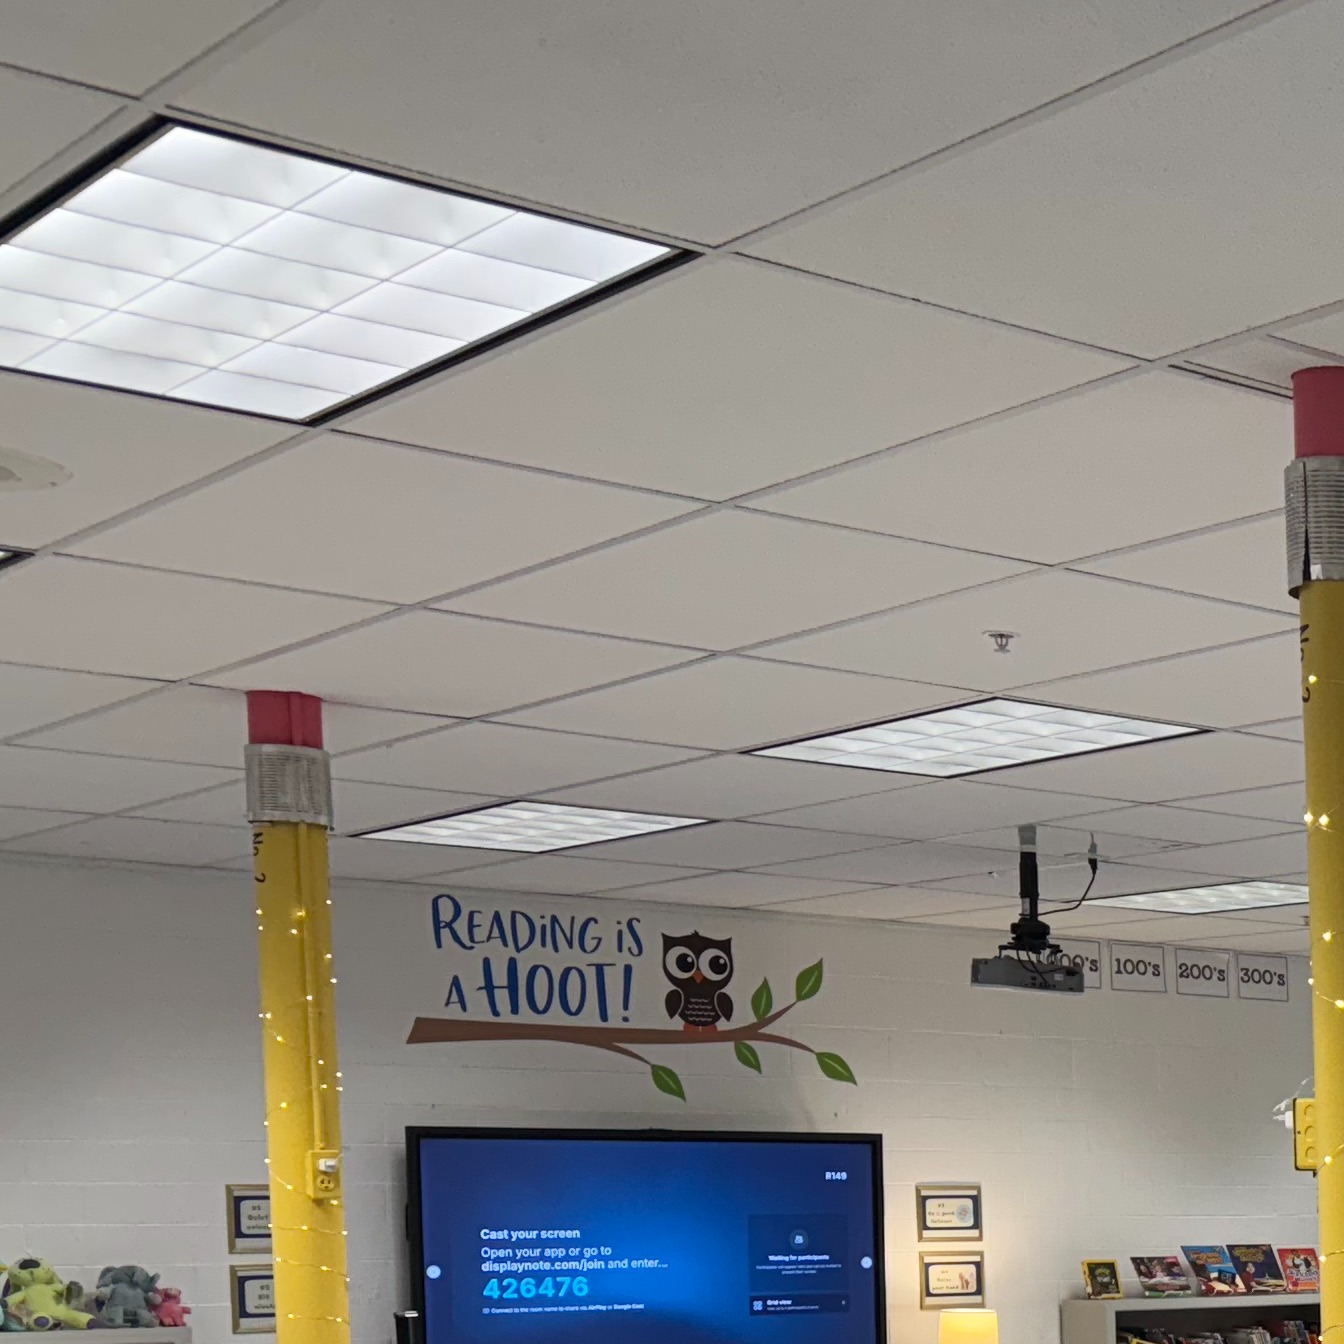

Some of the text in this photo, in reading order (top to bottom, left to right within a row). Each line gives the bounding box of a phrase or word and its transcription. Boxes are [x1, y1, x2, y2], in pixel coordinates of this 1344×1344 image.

[1115, 958, 1161, 976] 100's
[1178, 963, 1226, 982] 200's
[1240, 968, 1285, 986] 300's
[477, 957, 633, 1022] HOOT!
[481, 1229, 580, 1241] Cast your screen
[481, 1246, 612, 1259] Open your app or go to
[482, 1259, 604, 1273] displaynote.com/join
[608, 1259, 628, 1269] and
[483, 1276, 589, 1299] 426476
